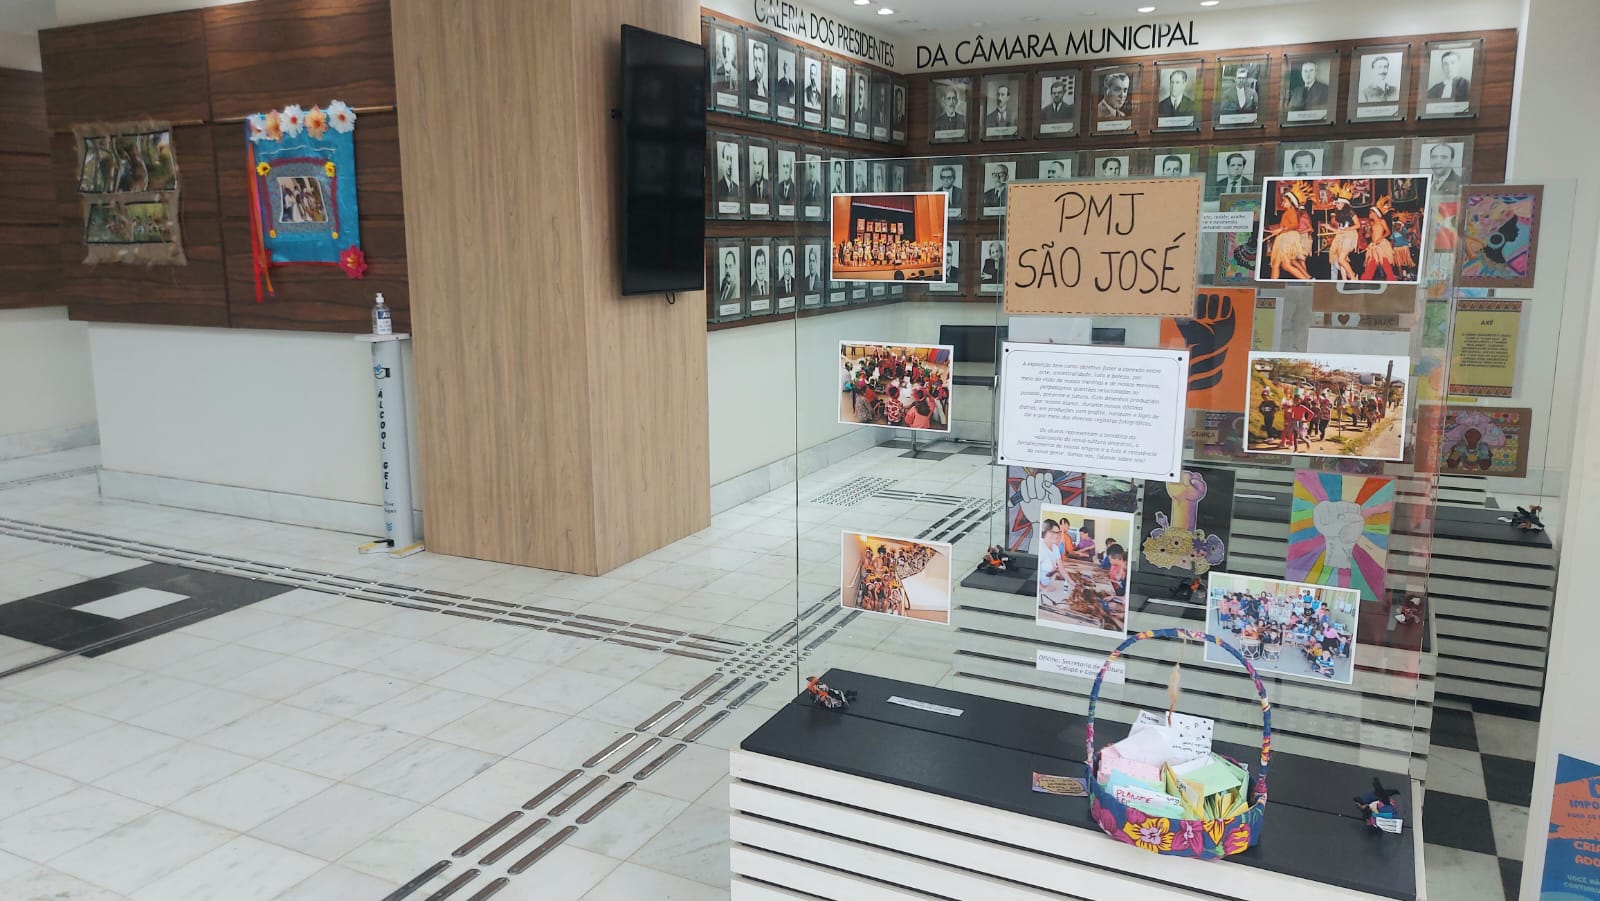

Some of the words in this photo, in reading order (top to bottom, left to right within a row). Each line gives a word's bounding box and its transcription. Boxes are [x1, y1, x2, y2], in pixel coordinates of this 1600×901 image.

[754, 0, 807, 38] GALERIA
[810, 13, 835, 47] DOS
[837, 23, 895, 68] PRESIDENTES
[916, 43, 948, 69] DA
[955, 32, 1058, 65] CÂMARA
[1065, 20, 1199, 56] MUNICIPAL
[1055, 191, 1145, 236] PMJ
[1014, 241, 1081, 289] SÃO
[1094, 232, 1186, 294] JOSÉ
